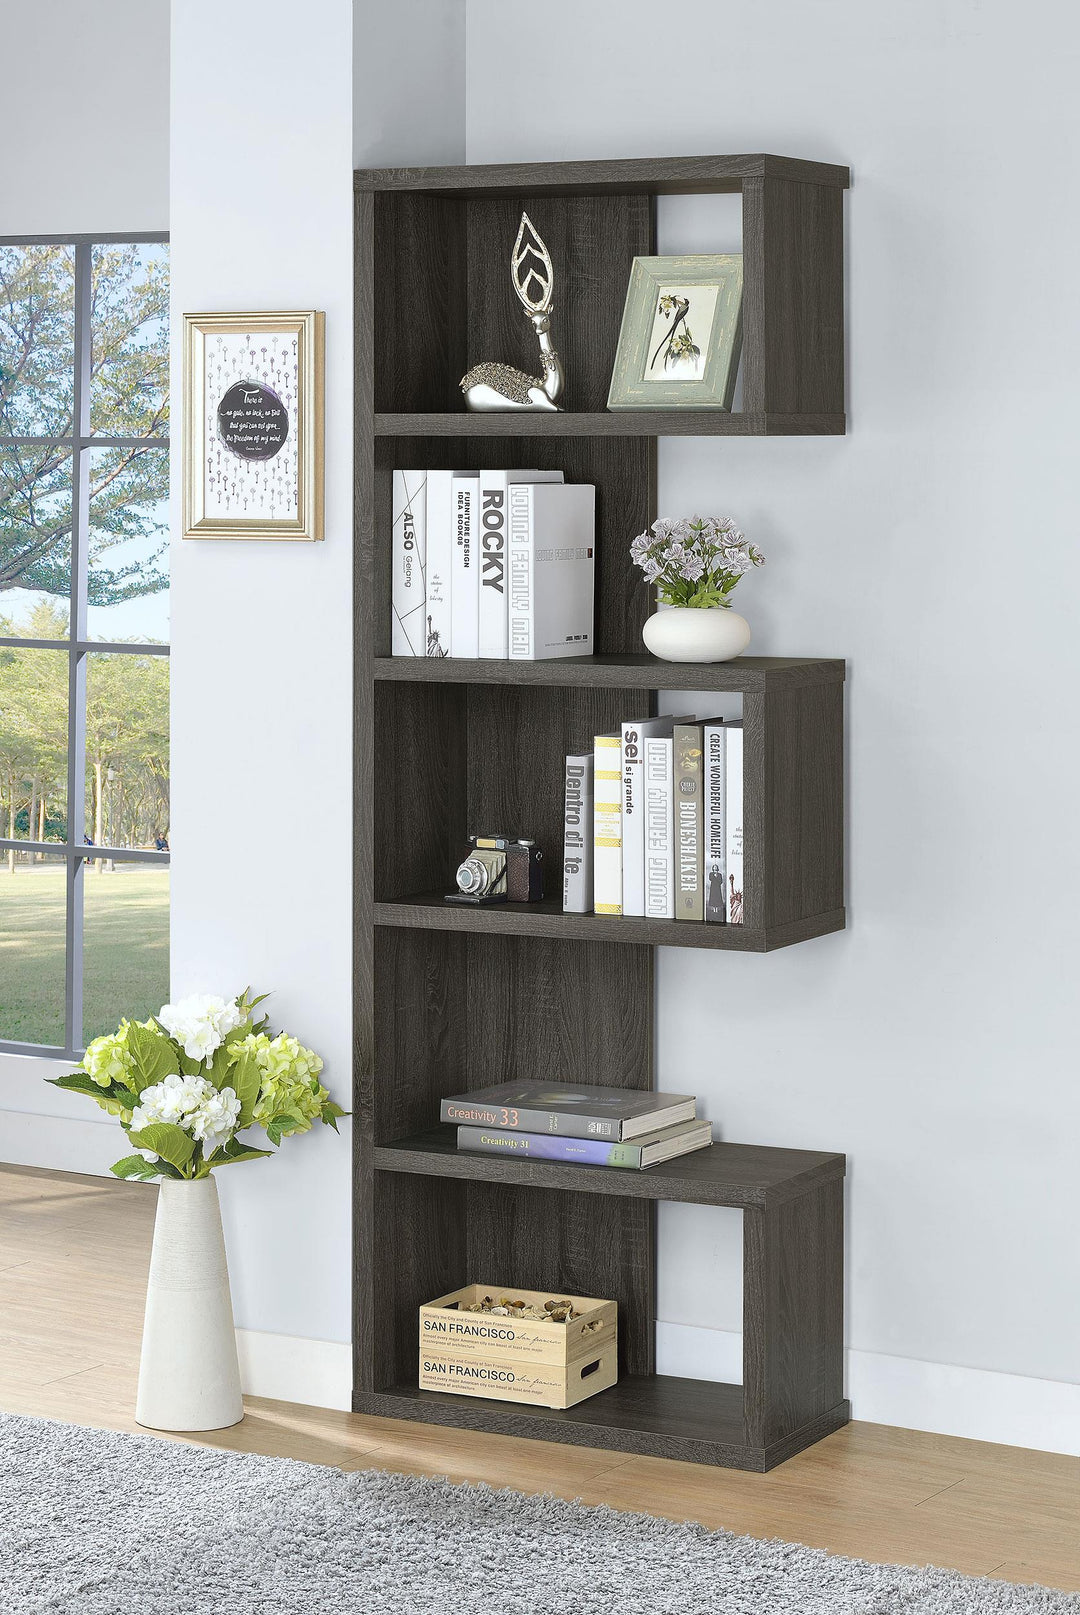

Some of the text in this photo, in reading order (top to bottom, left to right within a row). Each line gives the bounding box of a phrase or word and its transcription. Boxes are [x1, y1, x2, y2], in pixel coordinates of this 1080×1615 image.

[403, 511, 414, 550] ALSO
[463, 491, 471, 537] FURNITURE
[482, 489, 504, 594] ROCKY
[510, 487, 530, 655] LOVING FAMILY MAN
[624, 730, 643, 815] sei si grande
[709, 733, 721, 859] CREATE WONDERFUL HOMELIFE
[564, 765, 585, 875] Dentro di te
[648, 743, 667, 916] LOVING FAMILY MAN
[679, 801, 697, 892] BONESHAKER
[447, 1106, 519, 1127] Creativity 33
[481, 1135, 529, 1149] Creativity 31
[424, 1320, 515, 1341] SAN FRANCISCO
[424, 1361, 515, 1382] SAN FRANCISCO
